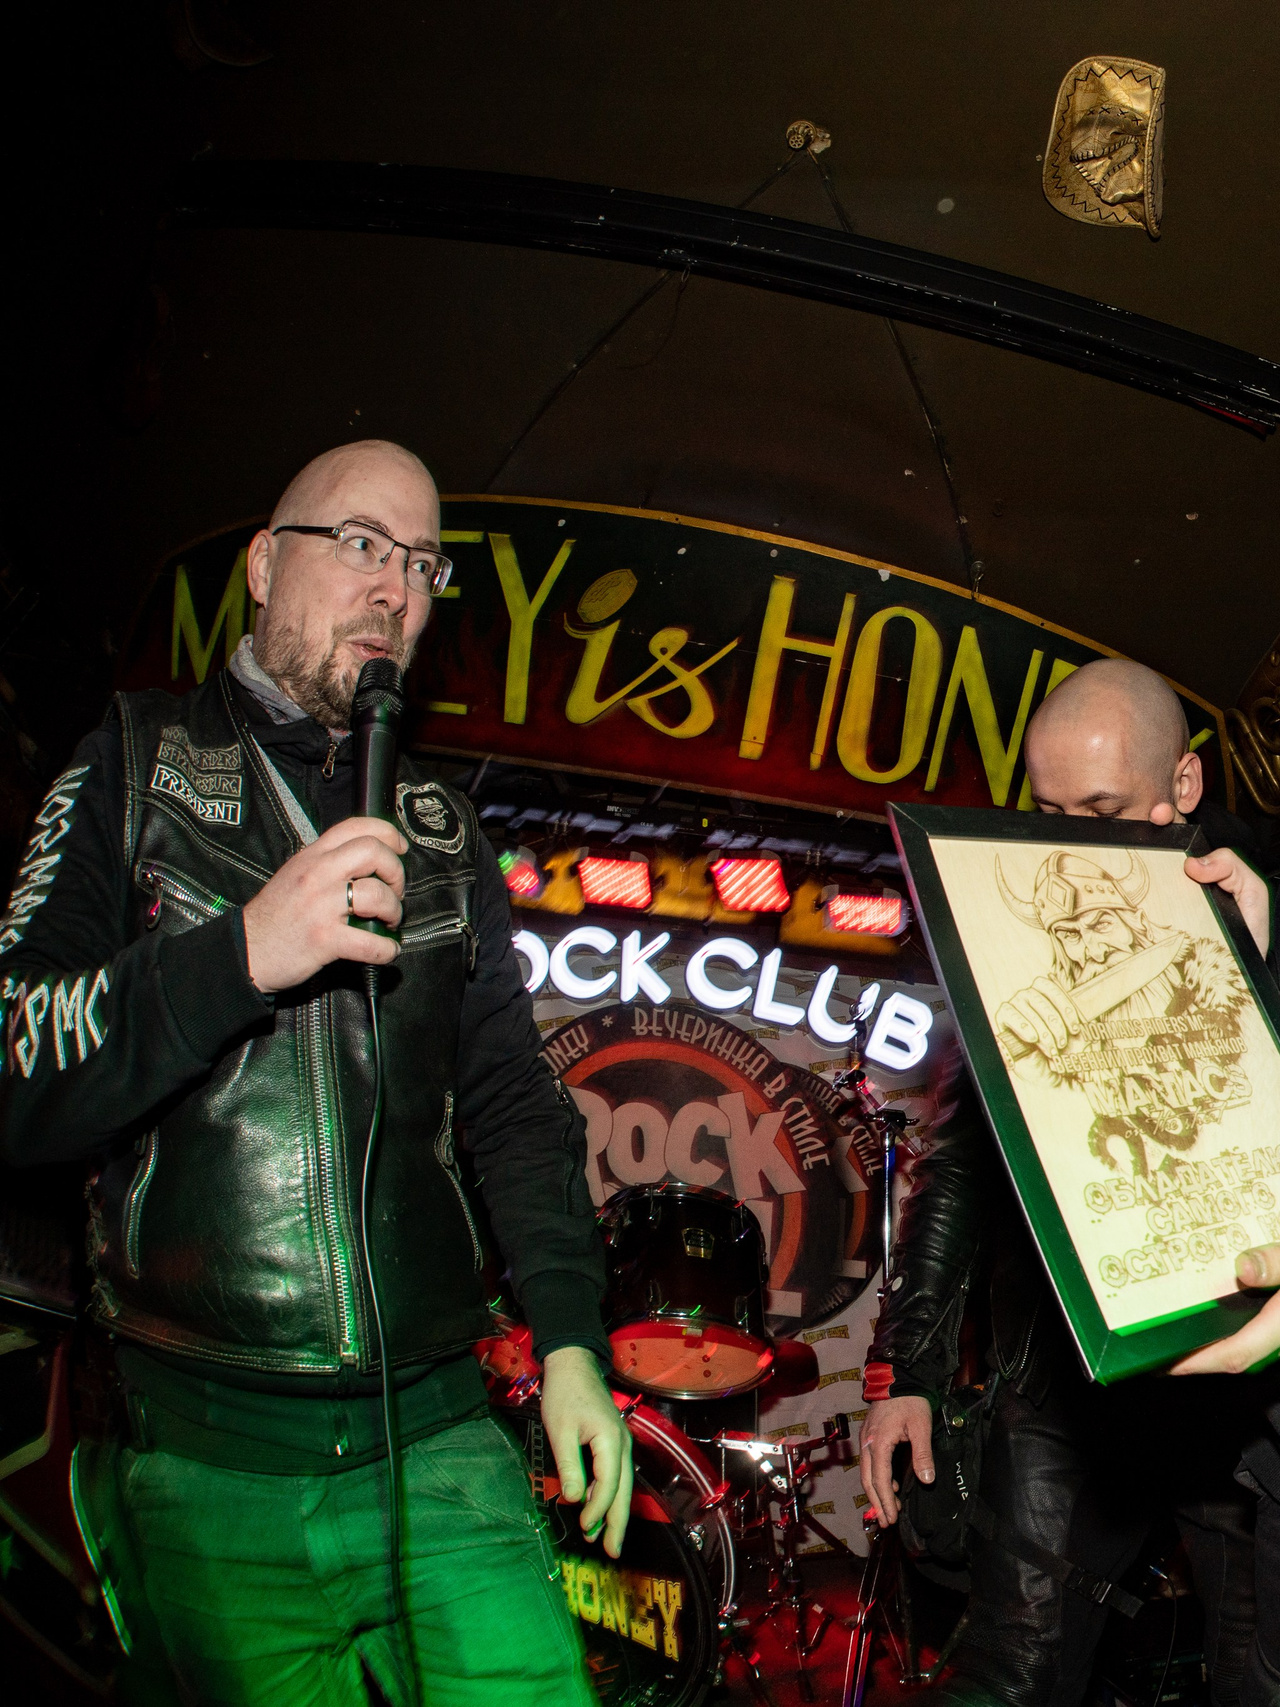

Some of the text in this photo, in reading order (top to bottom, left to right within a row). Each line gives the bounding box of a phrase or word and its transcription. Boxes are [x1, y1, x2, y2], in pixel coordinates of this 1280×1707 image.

[564, 568, 741, 739] is
[160, 769, 237, 821] PRESIDENT
[512, 925, 934, 1071] OCK CLUB
[1079, 1013, 1208, 1042] NORMANS RIDERS MC
[1052, 1036, 1249, 1074] ВЕСЕННИЙ ПРОХВАТ МАНЬЯКОВ
[630, 1006, 770, 1081] ВЕЧЕРИНКА
[780, 1096, 831, 1172] СТИЛЕ
[1146, 1181, 1277, 1238] САМОГО
[1098, 1222, 1252, 1289] ОСТРОГО
